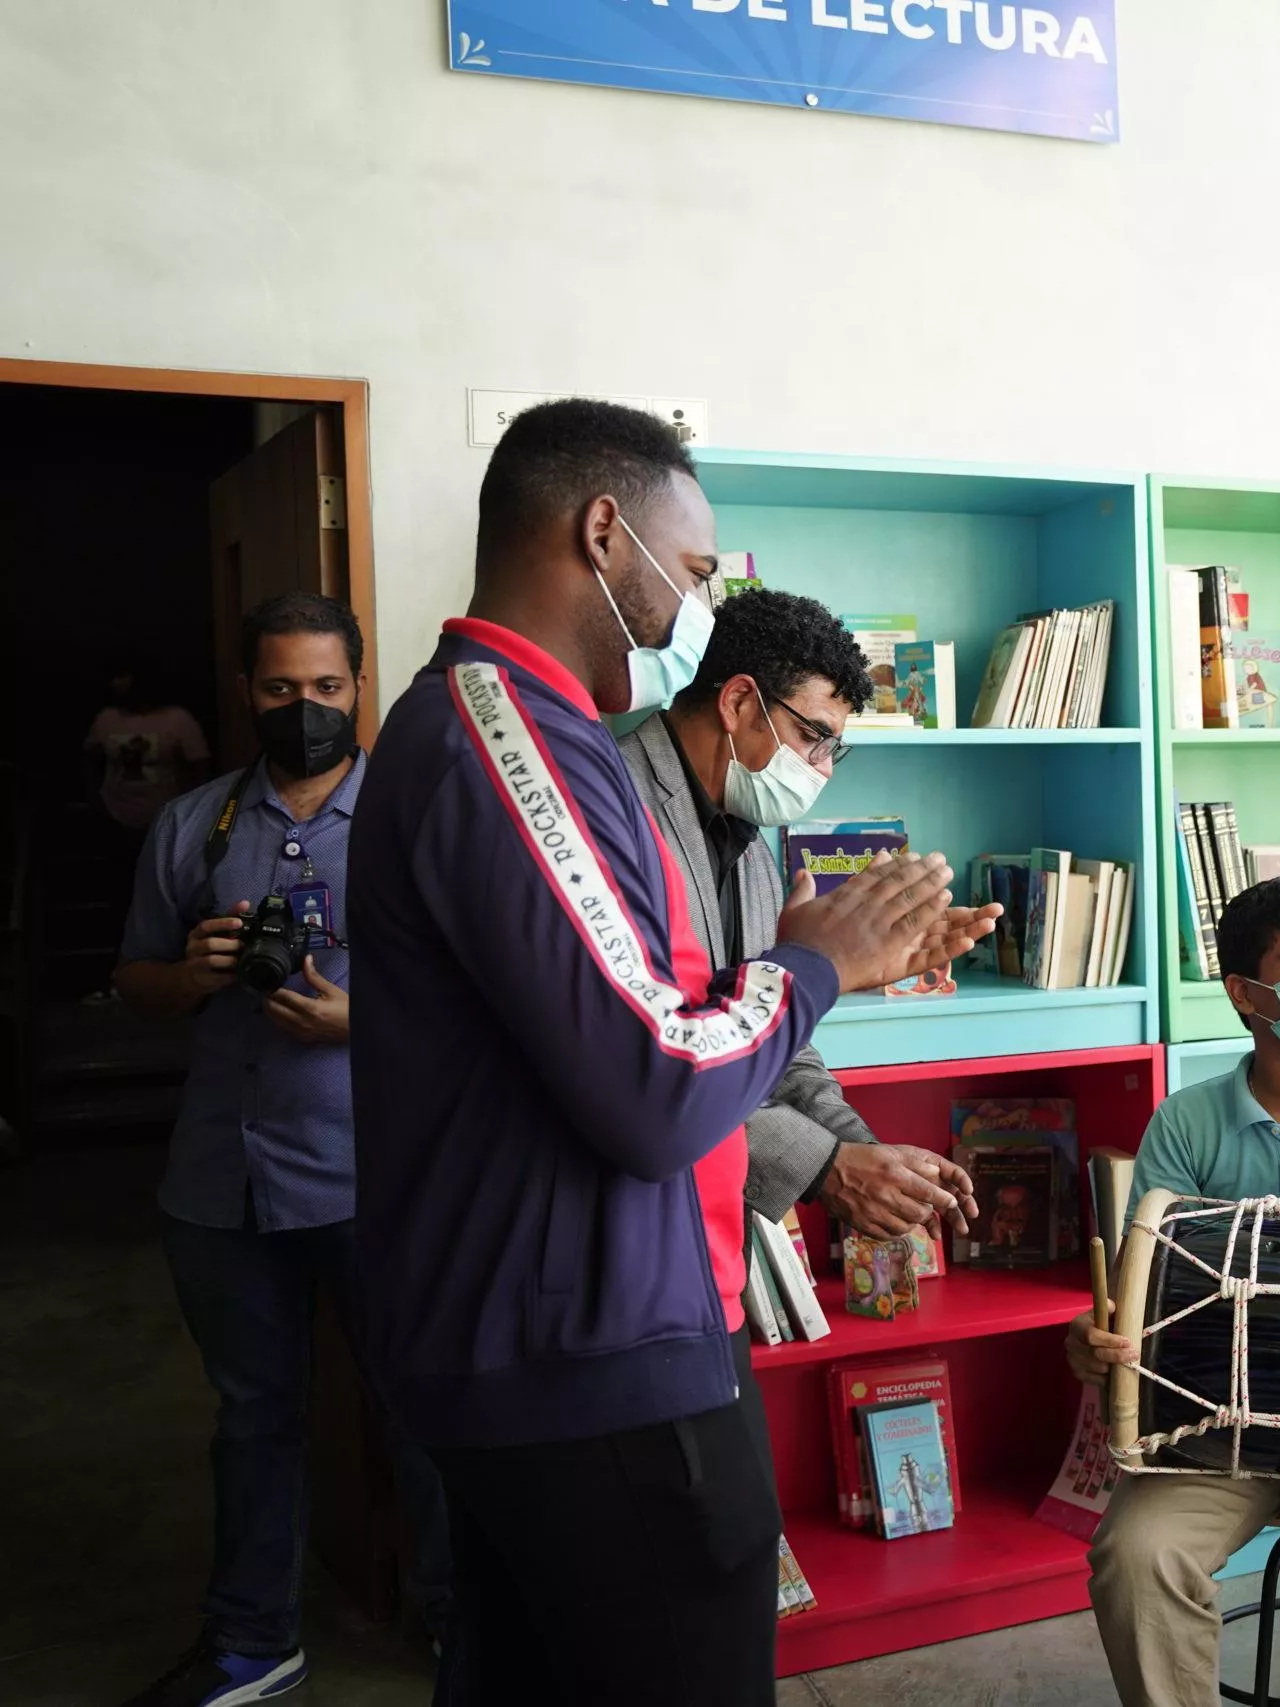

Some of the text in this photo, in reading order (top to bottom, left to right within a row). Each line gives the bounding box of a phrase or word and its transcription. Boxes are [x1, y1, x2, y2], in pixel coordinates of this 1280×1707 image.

[812, 0, 1107, 64] LECTURA
[218, 799, 237, 831] Nikon
[500, 751, 575, 865] ROCKSTAR
[801, 848, 819, 873] La
[818, 847, 854, 874] sonrisa
[262, 925, 281, 933] Nikon
[1200, 908, 1208, 921] 7
[580, 896, 661, 1004] ROCKSTAR
[876, 1380, 942, 1396] ENCICLOPEDIA
